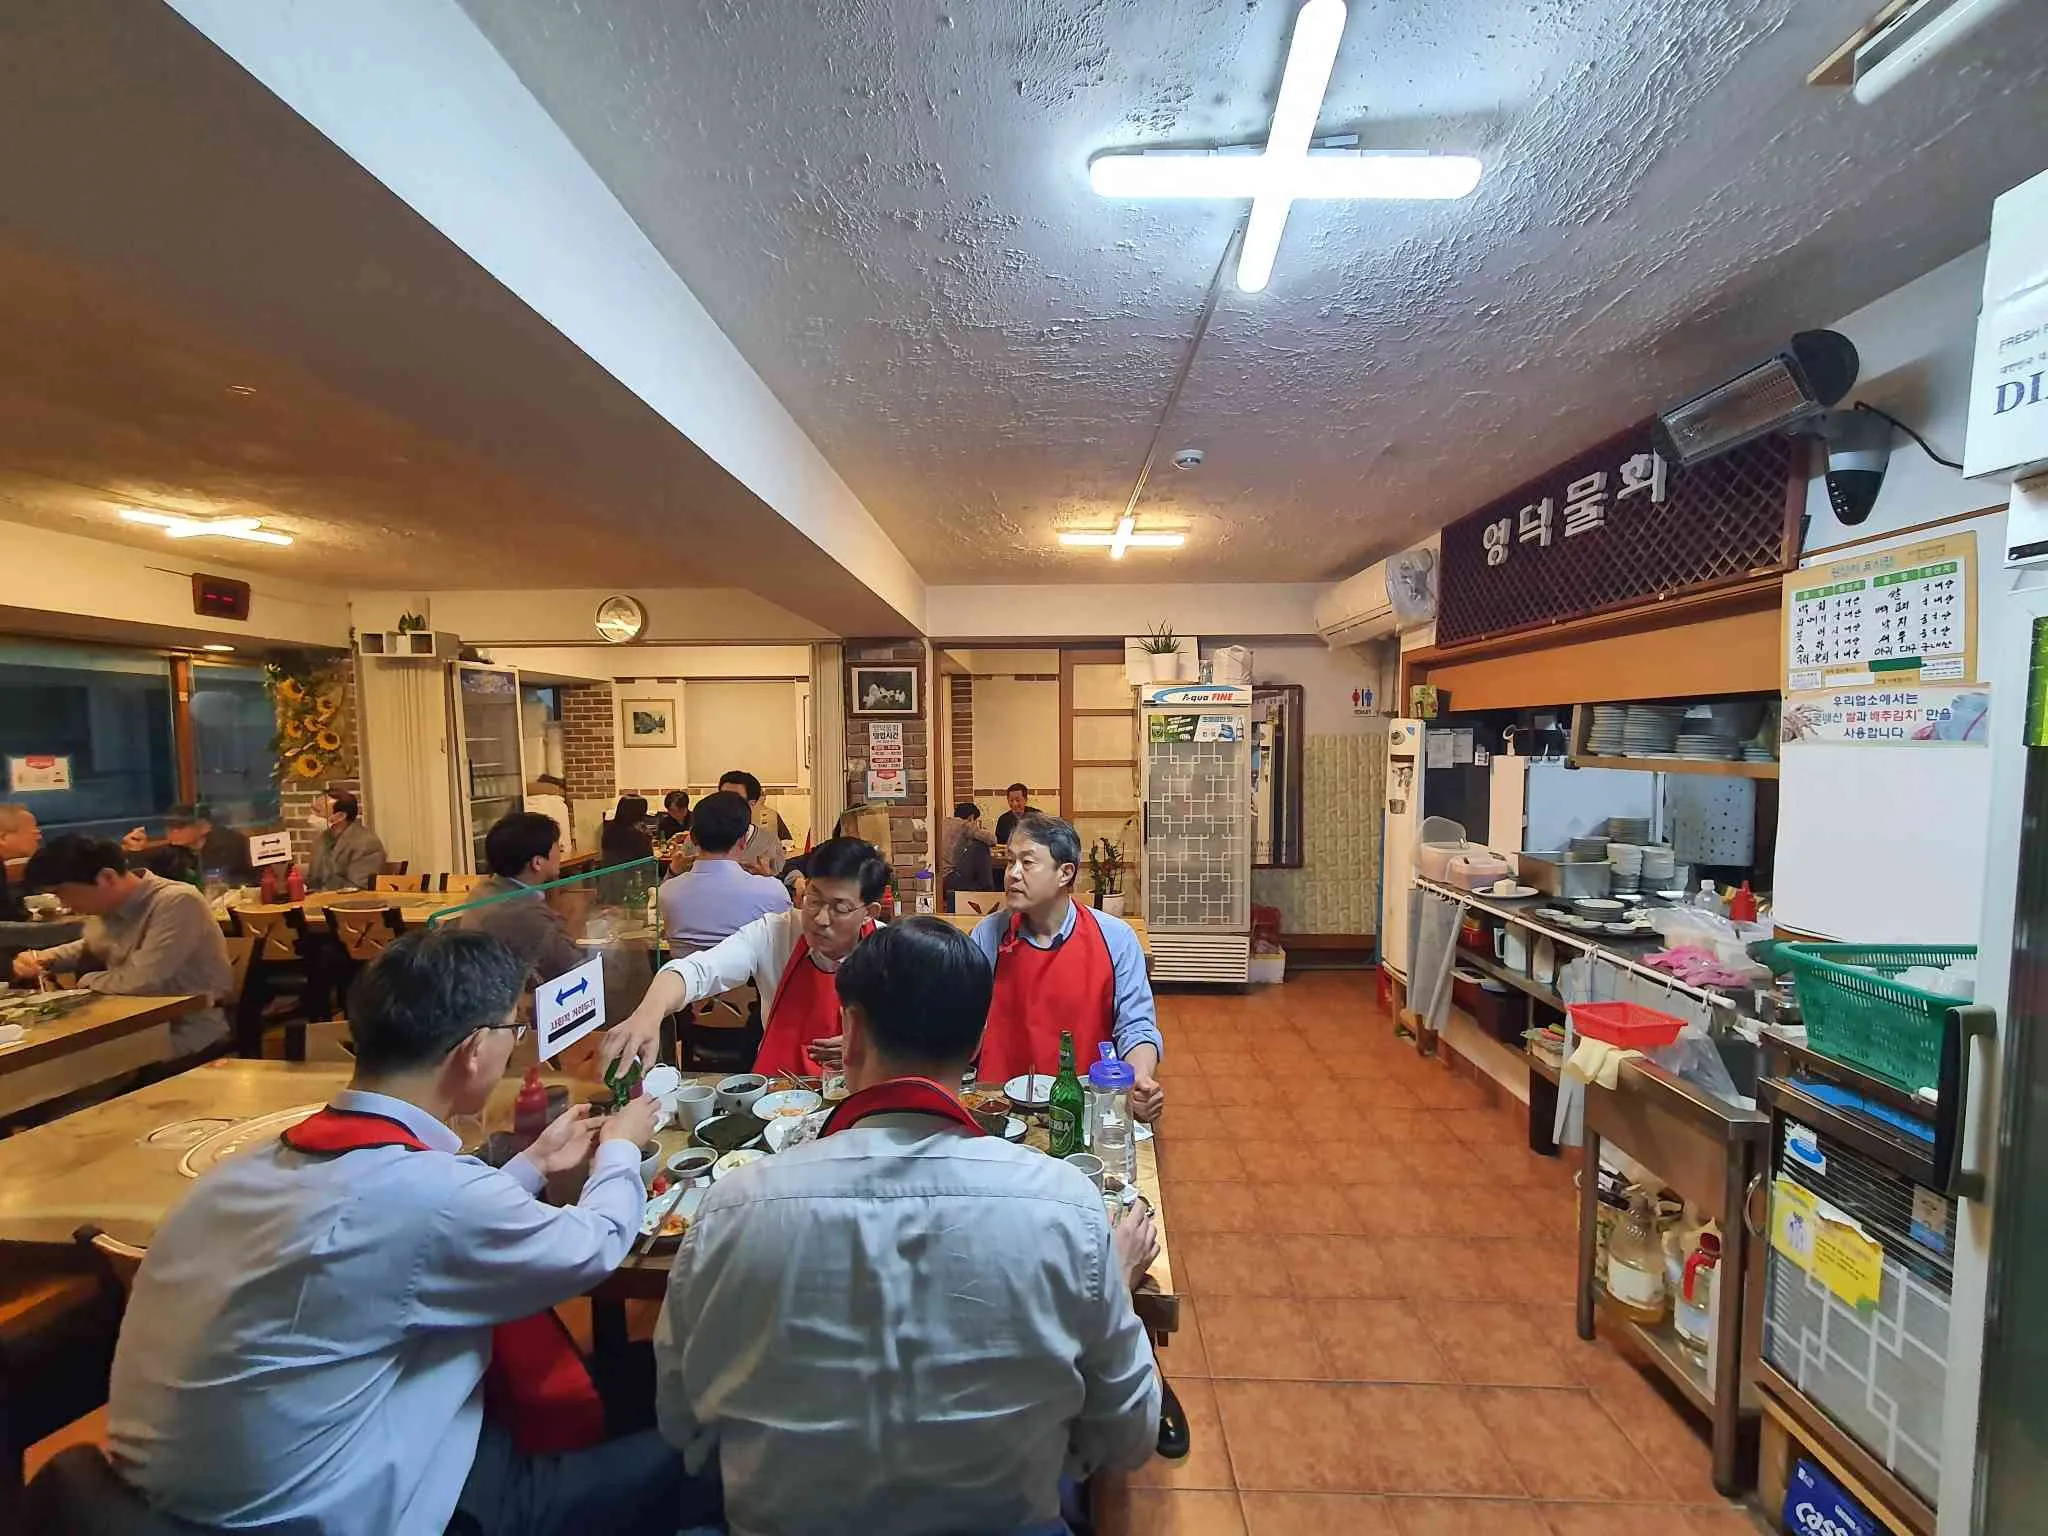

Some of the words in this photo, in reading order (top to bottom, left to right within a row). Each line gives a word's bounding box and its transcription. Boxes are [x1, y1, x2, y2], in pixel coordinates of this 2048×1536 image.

[1993, 370, 2048, 415] DI
[1483, 447, 1667, 566] 영덕물회
[1211, 693, 1234, 701] FINE
[1833, 692, 1919, 707] 우리업소에서는
[1845, 710, 1866, 723] 쌀과
[1925, 707, 1952, 721] 만을
[1843, 726, 1905, 740] 사용합니다
